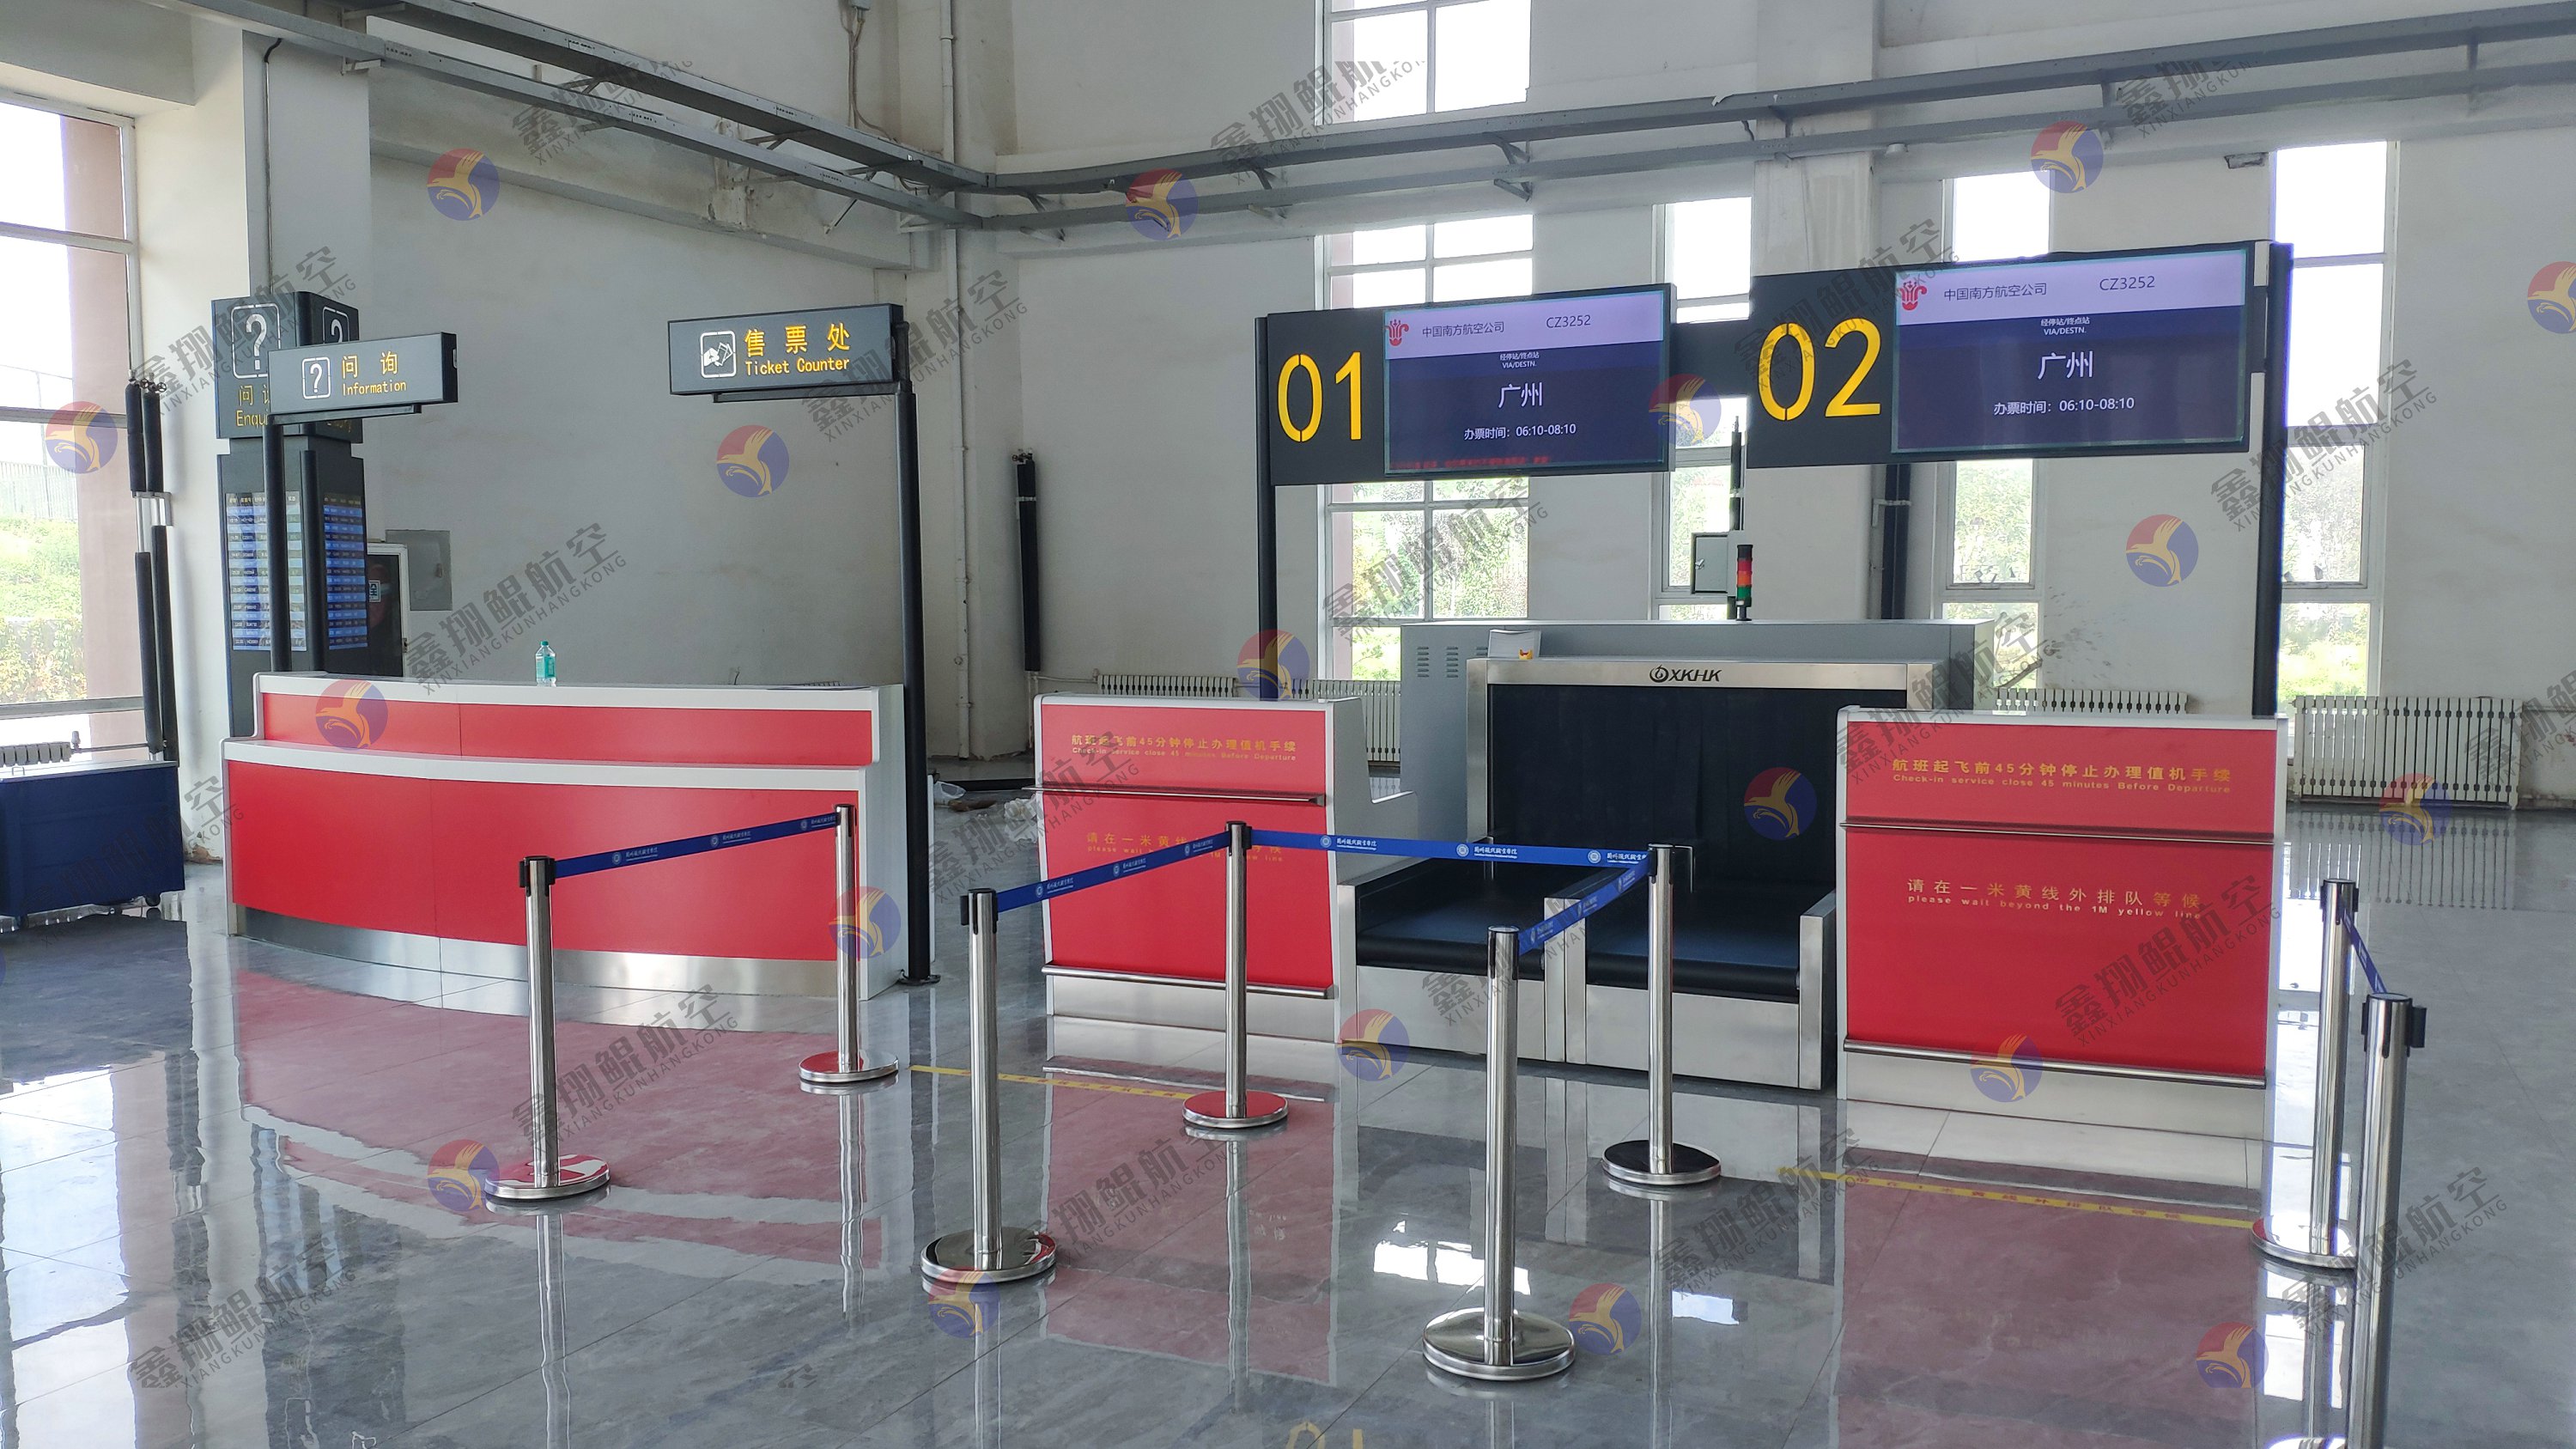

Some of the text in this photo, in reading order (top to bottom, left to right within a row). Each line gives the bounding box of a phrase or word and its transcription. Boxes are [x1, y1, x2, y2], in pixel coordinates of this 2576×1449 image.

[1943, 276, 2155, 302] 中国南方航空公司 CZ3252
[1422, 314, 1591, 338] 中国南方航空公司 CZ3252
[744, 323, 850, 357] 售票处
[343, 350, 398, 379] 问询
[745, 356, 850, 375] Ticket Counter
[1757, 318, 1881, 422] 02
[2037, 350, 2094, 380] 广州
[238, 385, 270, 406] 问
[343, 381, 406, 396] Information
[1277, 351, 1362, 442] 01
[1498, 381, 1543, 409] 广州
[236, 411, 268, 428] Enqui
[1668, 669, 1722, 681] XKHK
[1892, 758, 2231, 782] 航班起飞前45分钟停止办理值机手续
[1893, 775, 2231, 794] Check-in service close 45 minutes Before Departure
[1907, 878, 2200, 909] 请在一米黄线外排队等候
[1908, 895, 2201, 920] please wait beyond the 1M yellow line
